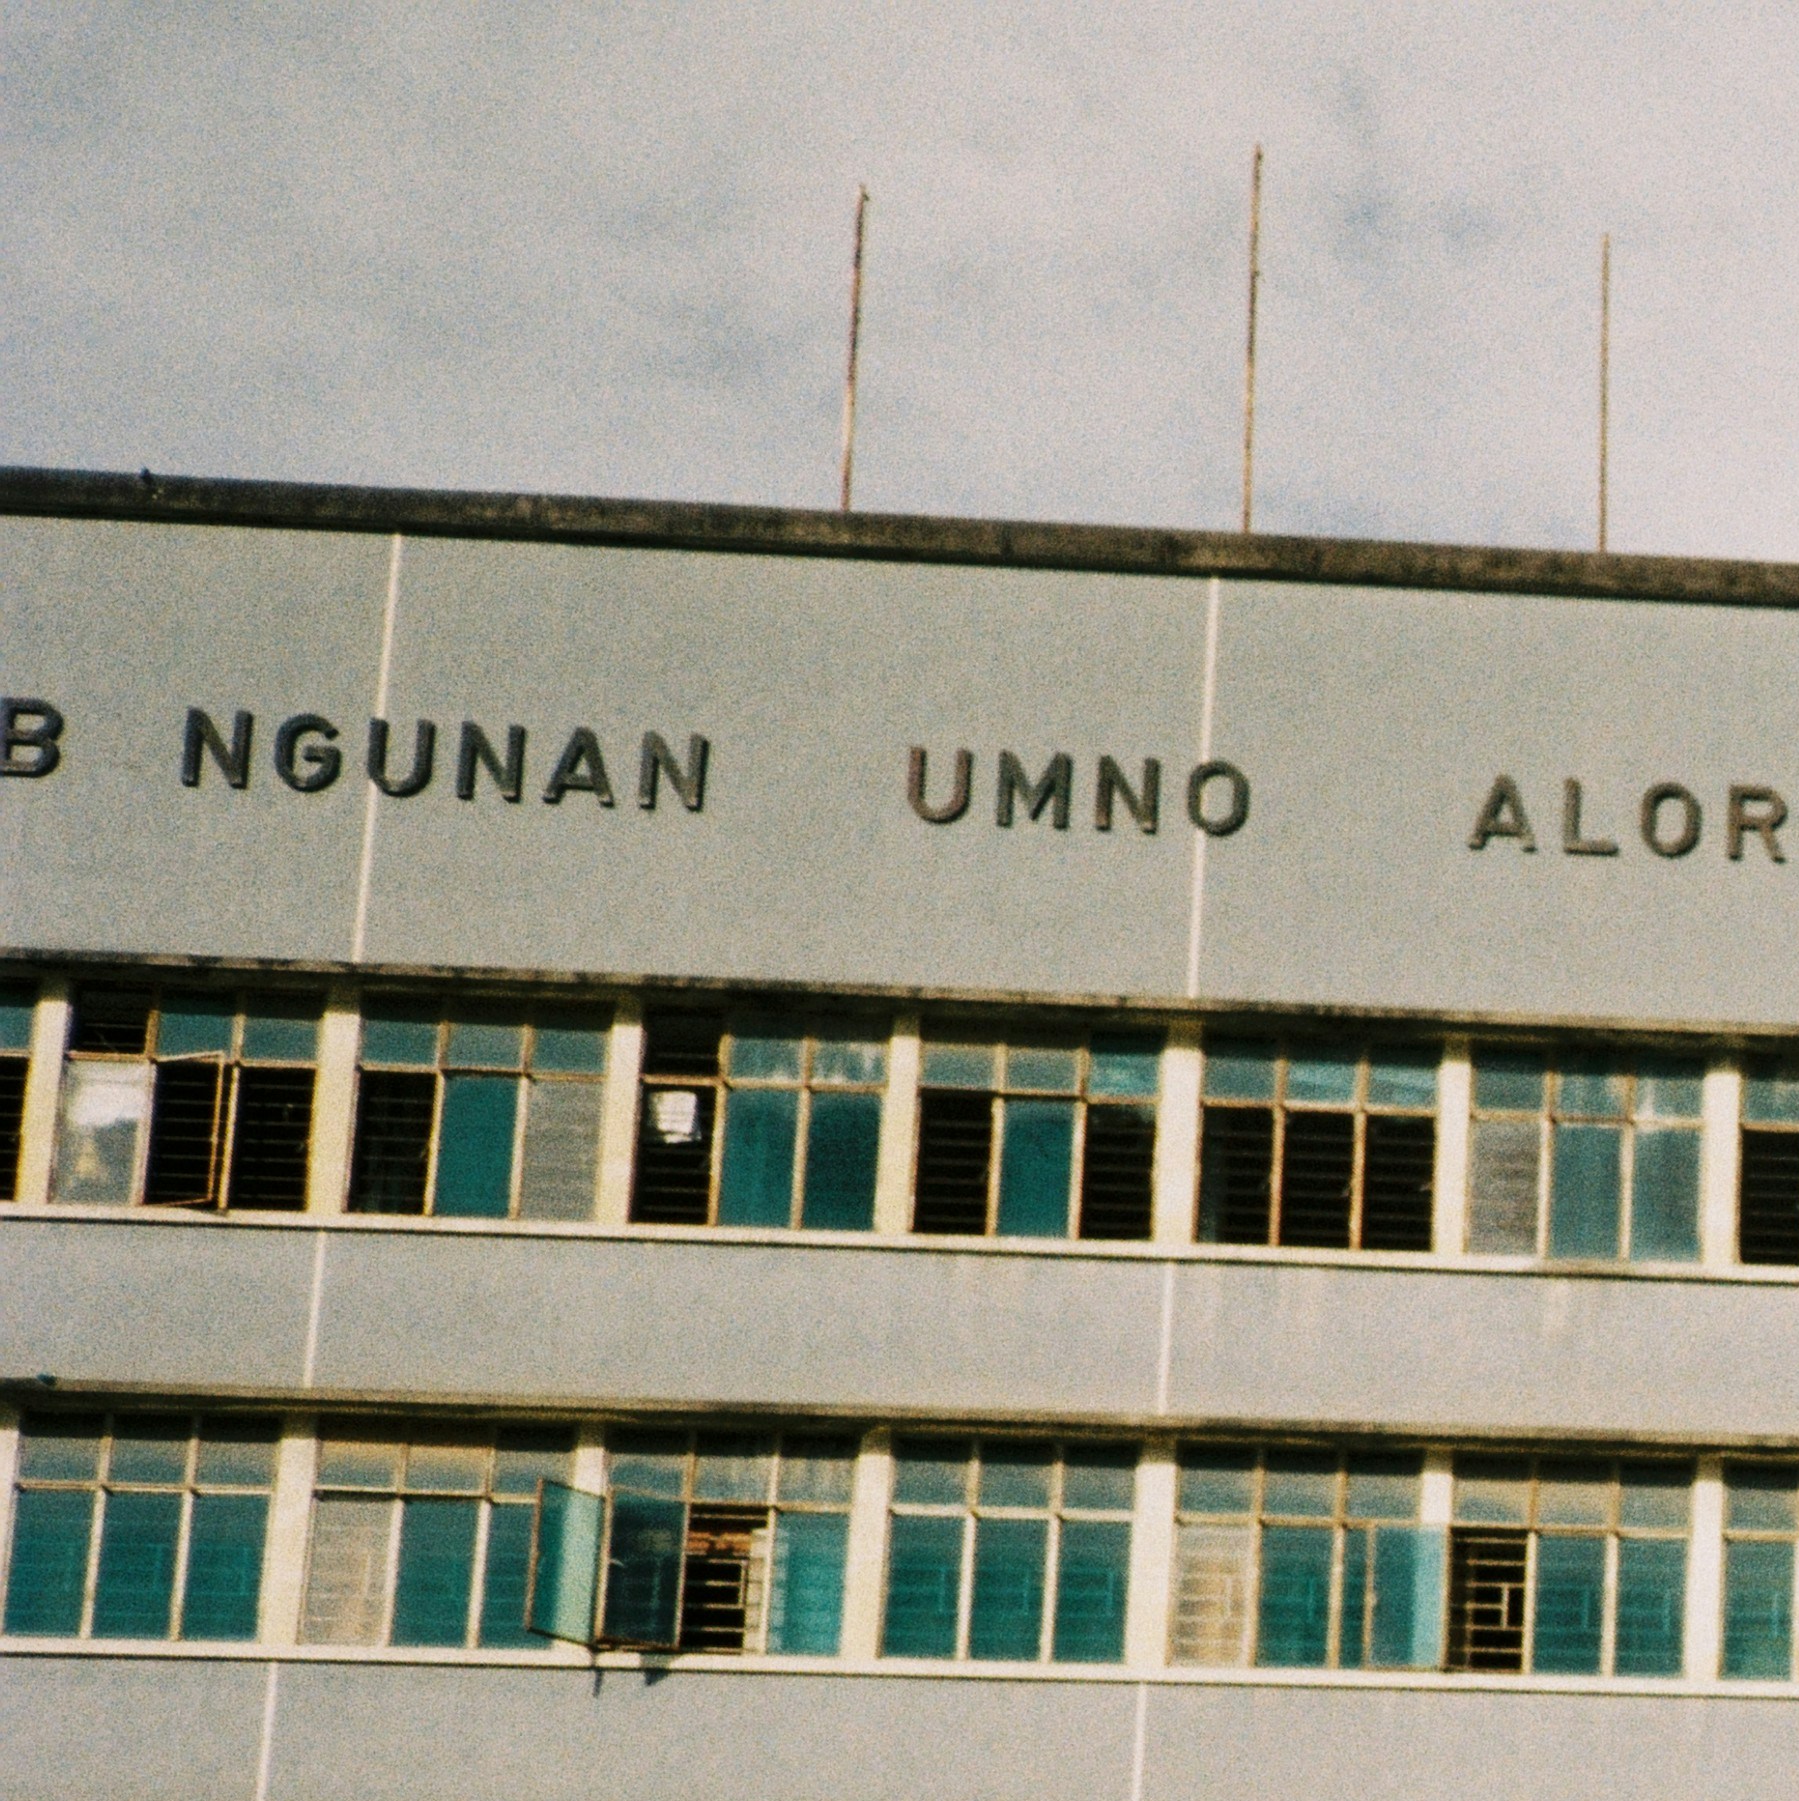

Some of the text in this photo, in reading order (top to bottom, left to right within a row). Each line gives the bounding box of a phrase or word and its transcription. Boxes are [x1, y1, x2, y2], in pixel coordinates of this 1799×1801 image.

[181, 707, 712, 814] NGUNAN
[907, 746, 1251, 839] UMNO
[1468, 775, 1790, 866] ALOR
